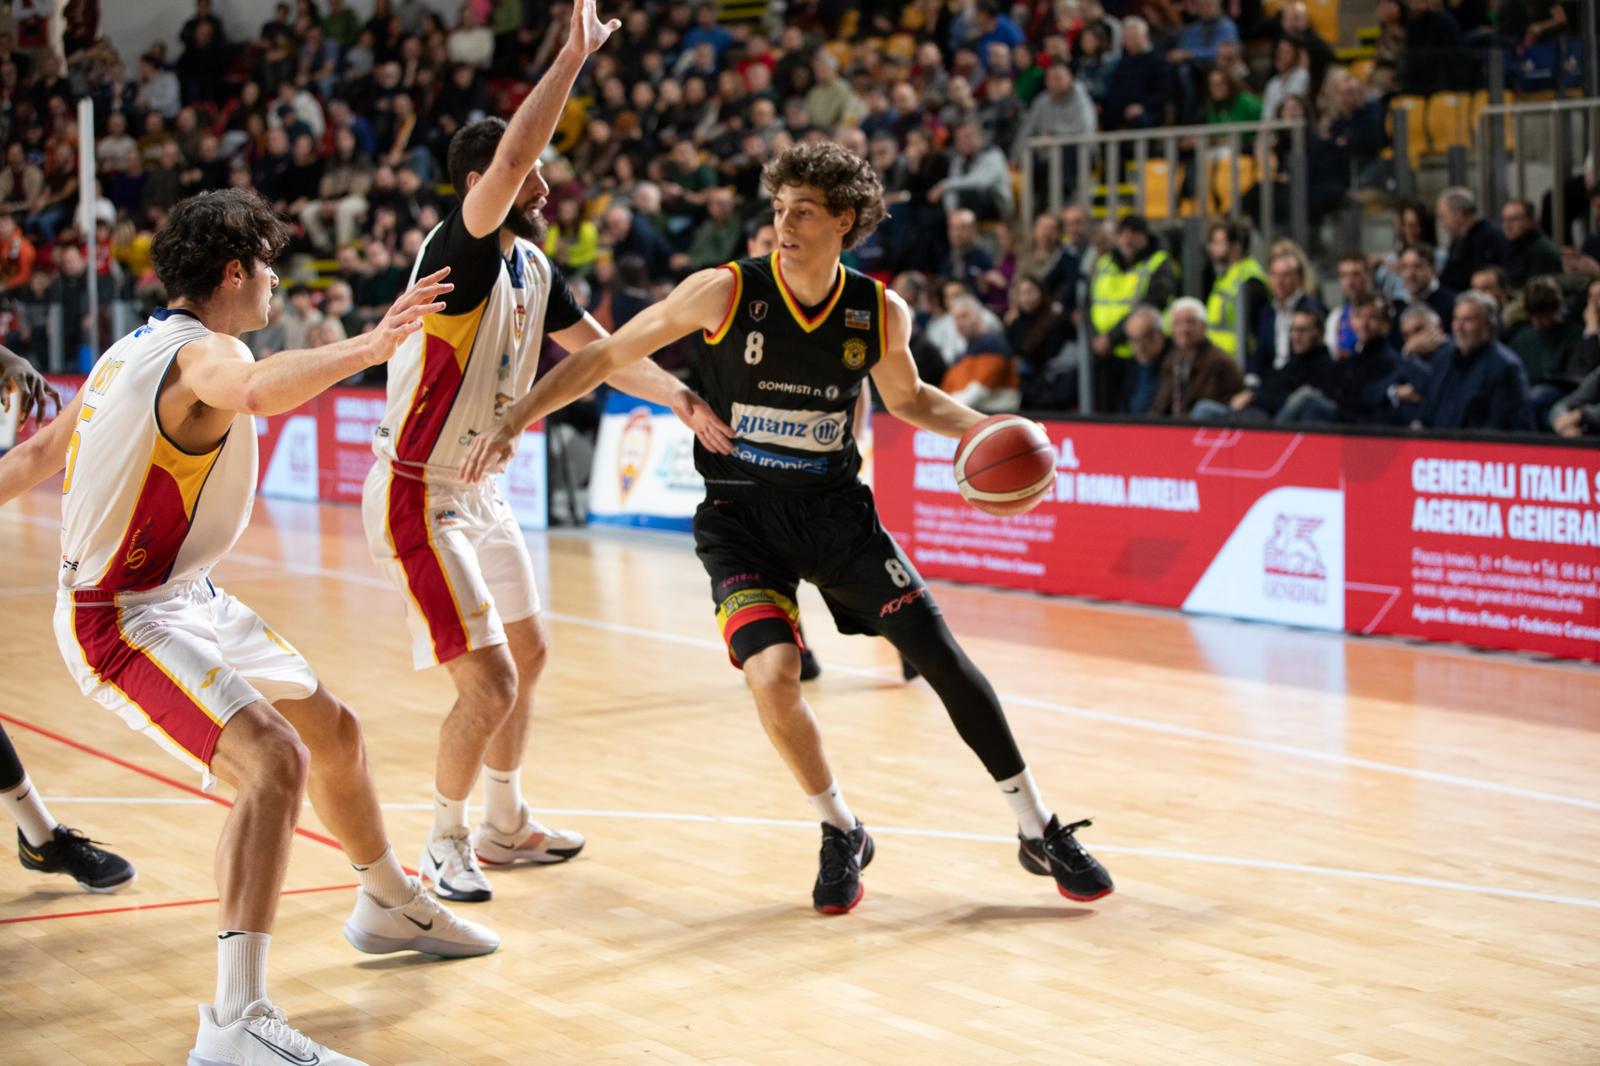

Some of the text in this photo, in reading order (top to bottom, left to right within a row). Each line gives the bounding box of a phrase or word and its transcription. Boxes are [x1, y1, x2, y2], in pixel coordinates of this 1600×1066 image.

[744, 331, 764, 365] 8
[757, 380, 812, 395] GOMMISTI
[735, 414, 809, 438] Allianz
[1128, 475, 1200, 512] AURELIA
[1411, 458, 1516, 498] GENERALI
[1520, 464, 1591, 504] ITALIA
[1411, 497, 1504, 539] AGENZIA
[884, 558, 911, 588] 8
